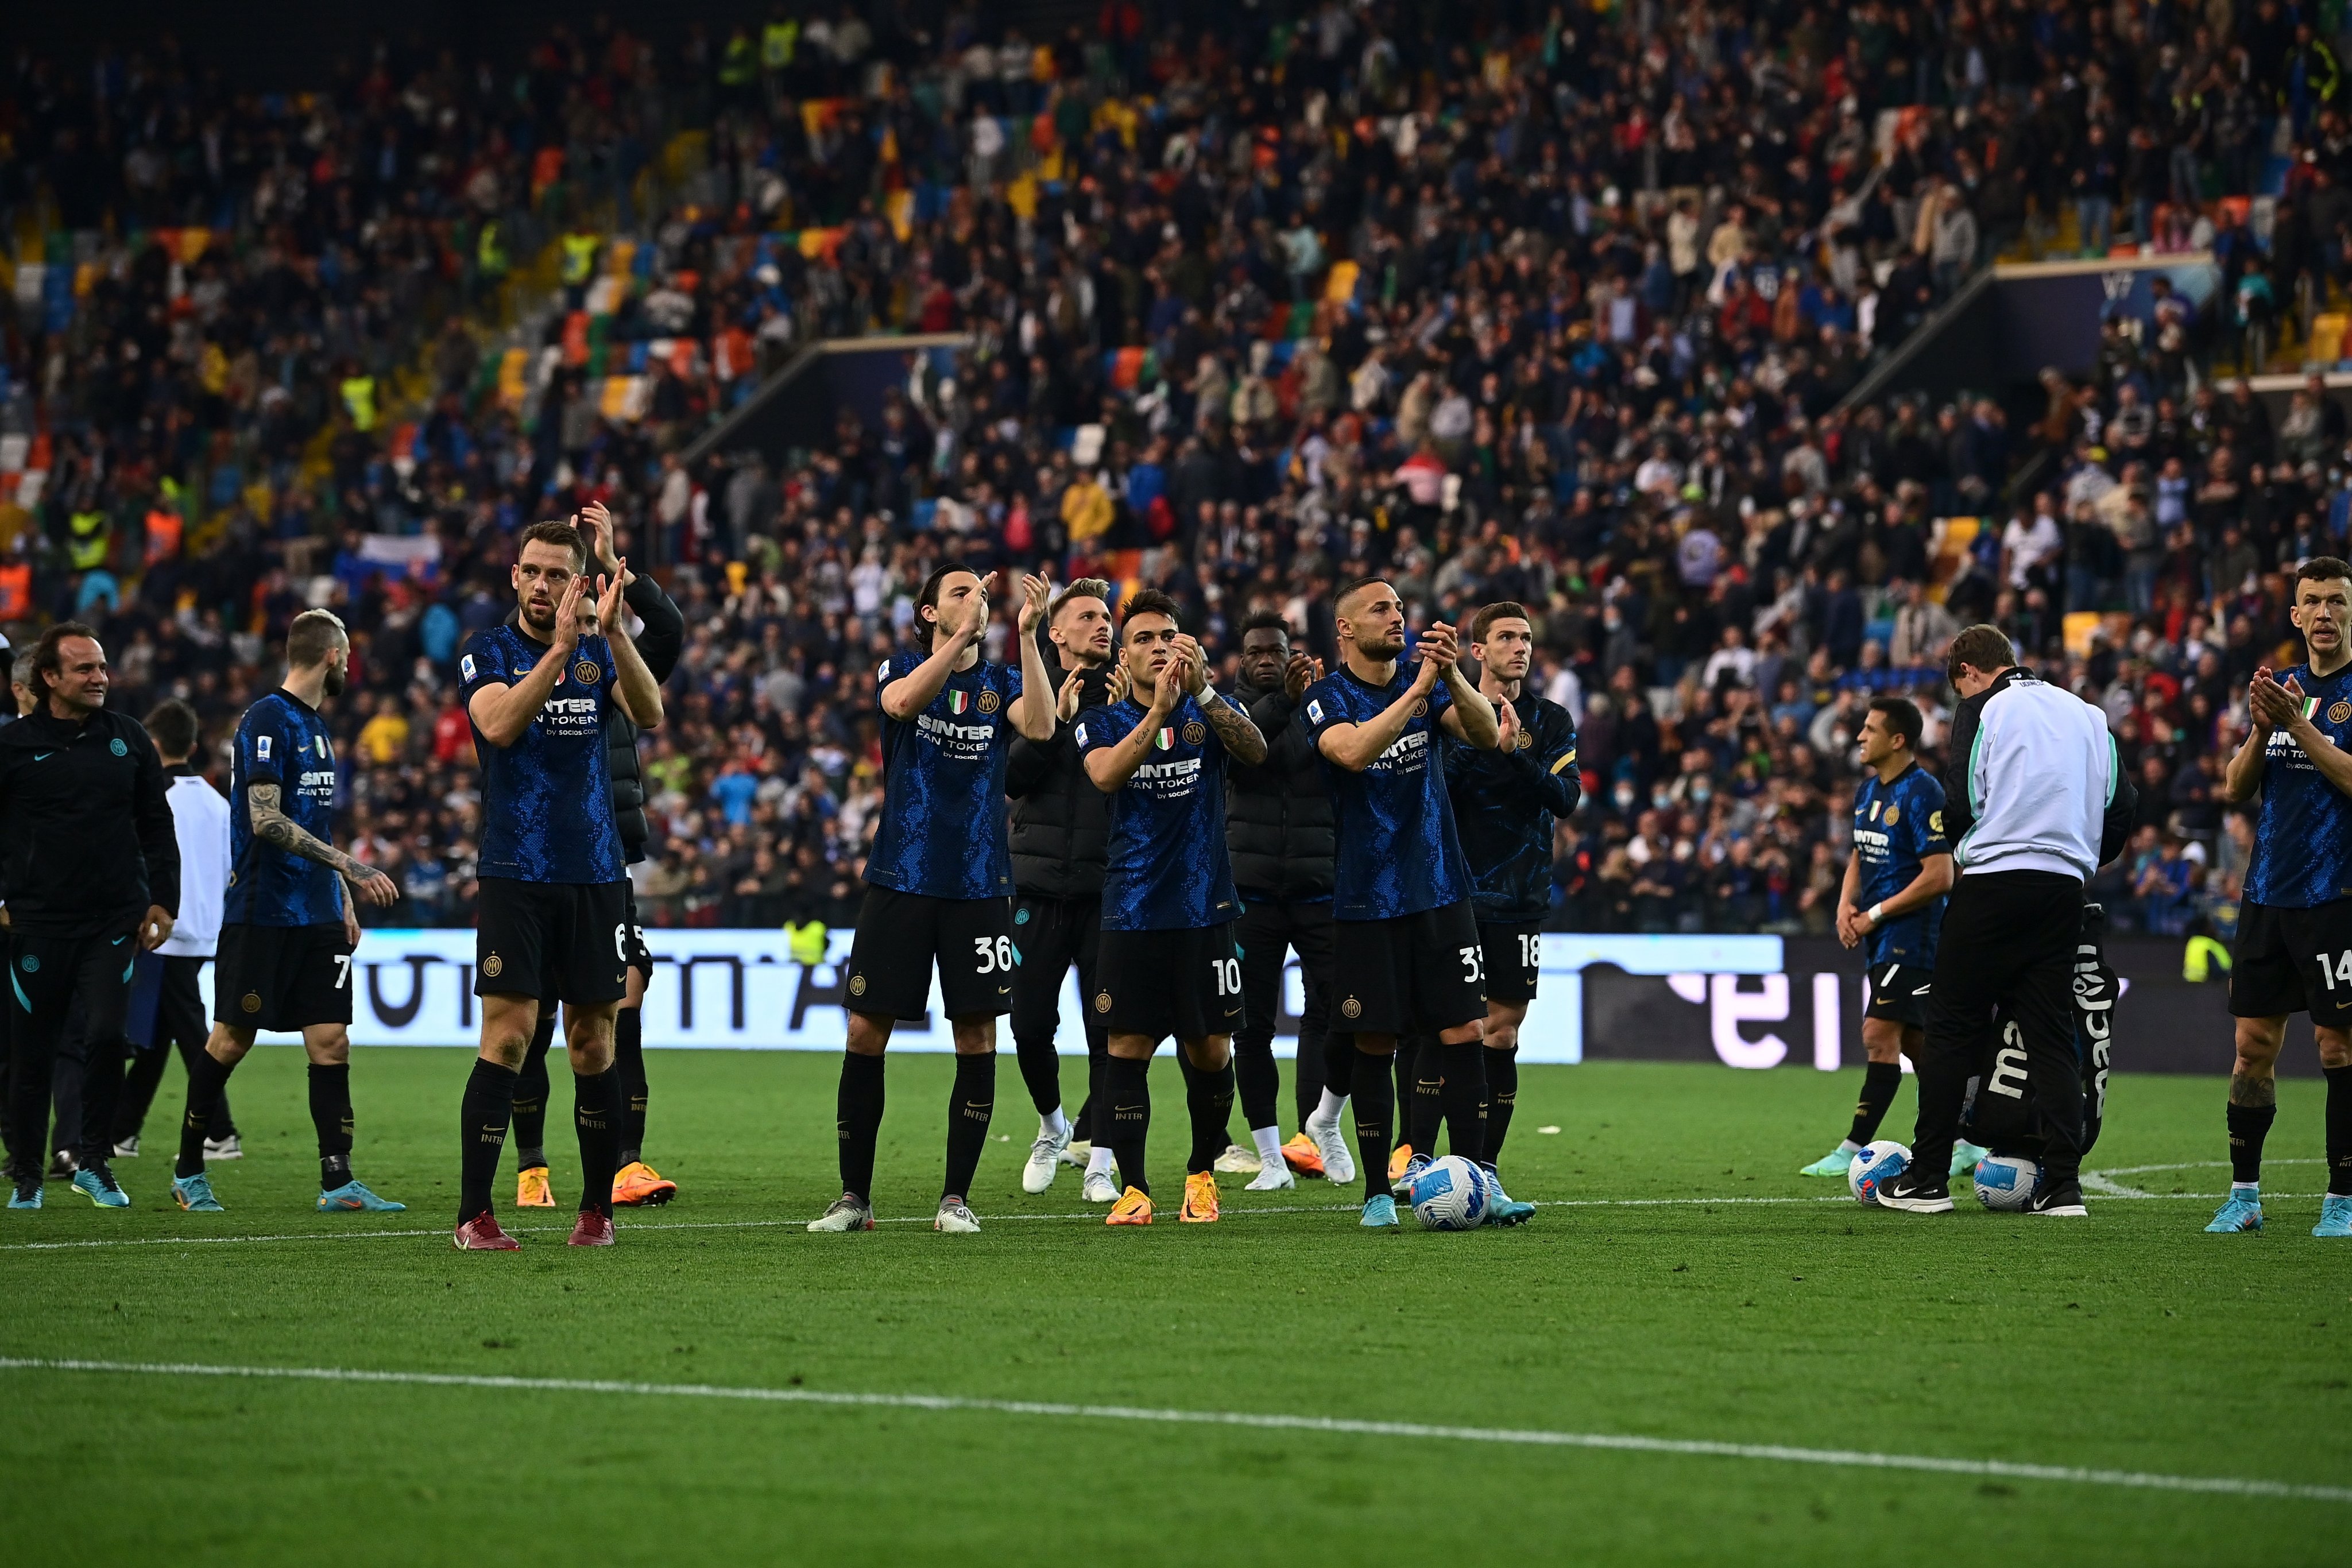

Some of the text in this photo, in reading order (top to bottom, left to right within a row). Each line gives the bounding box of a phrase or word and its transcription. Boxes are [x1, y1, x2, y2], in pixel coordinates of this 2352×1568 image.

[543, 698, 597, 714] NTER
[550, 715, 598, 725] TOKEN
[916, 729, 941, 745] FAN
[1380, 730, 1428, 758] NTER
[2265, 748, 2286, 757] FAN
[2286, 761, 2295, 769] by
[297, 788, 317, 796] FAN
[1127, 781, 1152, 789] FAN
[615, 923, 626, 962] 6
[975, 935, 1012, 974] 36
[1518, 934, 1540, 967] 18
[334, 955, 350, 989] 7
[2316, 949, 2352, 990] 14
[1212, 958, 1241, 996] 10
[964, 1108, 988, 1122] INTER
[580, 1116, 606, 1129] INTER
[838, 1130, 850, 1139] TER
[1358, 1129, 1379, 1137] INTER
[2229, 1137, 2245, 1147] NTER
